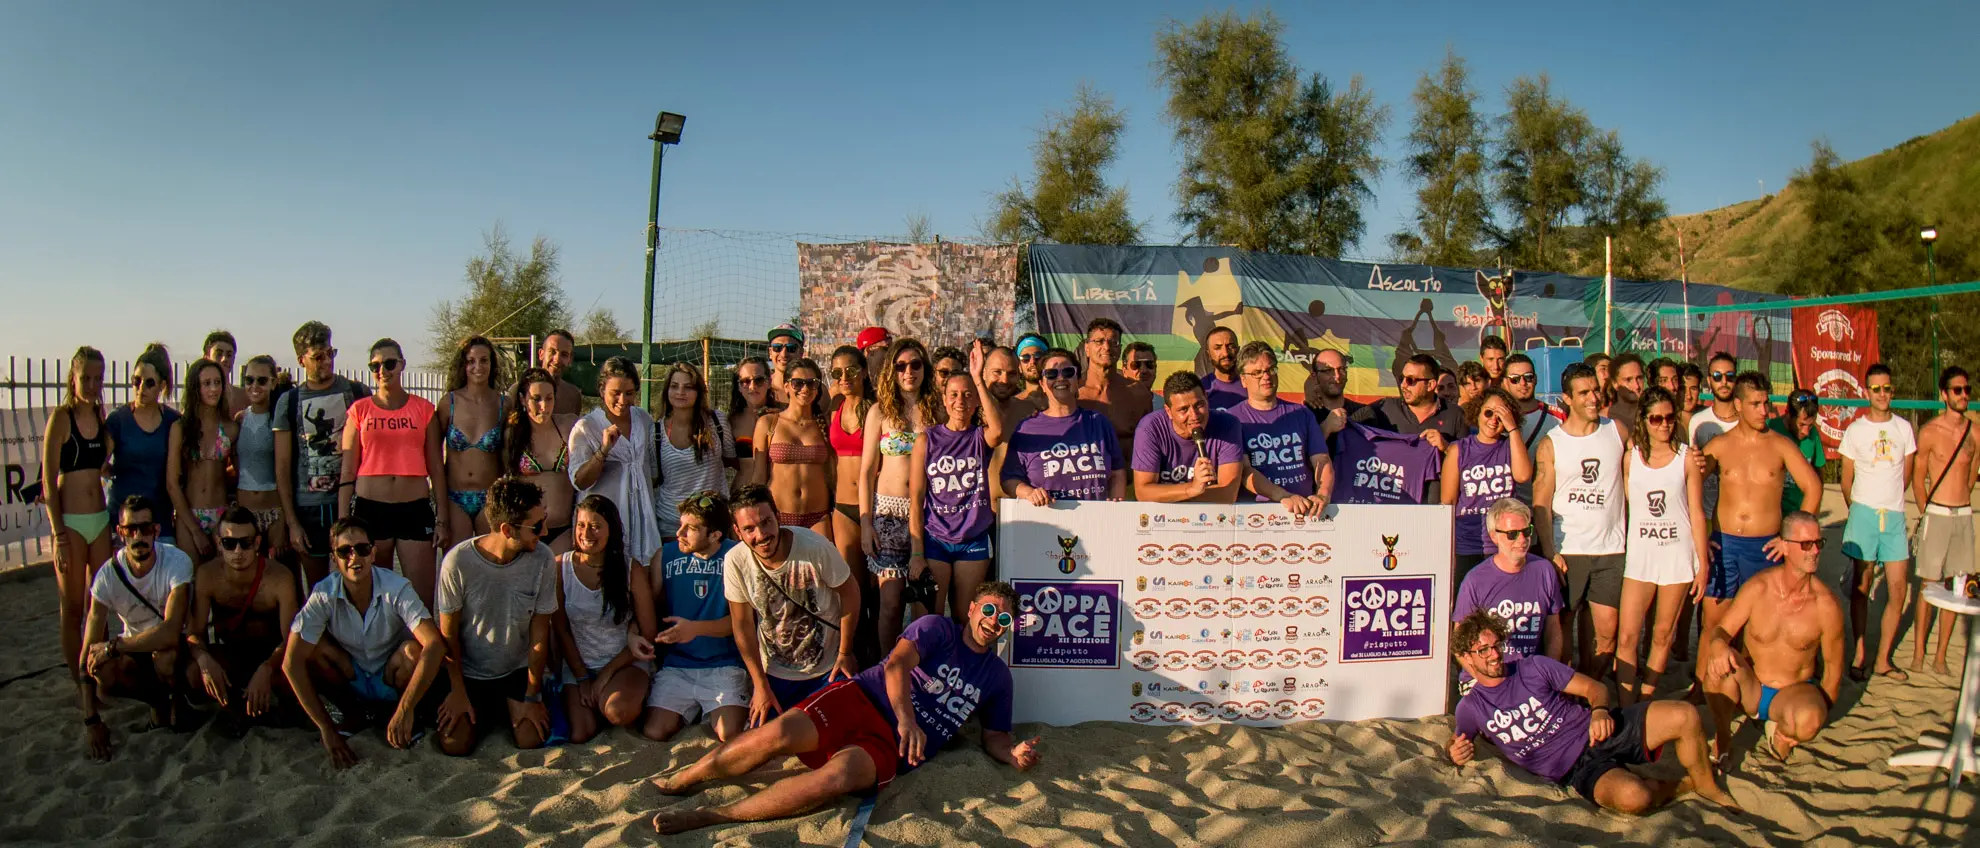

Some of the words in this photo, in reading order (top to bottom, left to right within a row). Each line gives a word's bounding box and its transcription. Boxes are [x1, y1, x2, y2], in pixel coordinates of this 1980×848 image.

[1368, 264, 1442, 293] ASCOLTO
[1072, 279, 1158, 302] LIBERTÀ
[1810, 346, 1851, 363] Sponsored
[1853, 350, 1861, 365] by
[366, 417, 417, 431] FITGIRL
[1040, 442, 1101, 460] COPPA
[1247, 432, 1302, 449] COPPA
[1047, 455, 1106, 477] PACE
[1255, 445, 1304, 466] PACE
[1356, 456, 1404, 477] COPPA
[933, 469, 984, 495] PACE
[1268, 473, 1307, 486] spetto
[1358, 472, 1404, 493] PACE
[1467, 477, 1513, 497] PACE
[1567, 493, 1605, 505] PACE
[1639, 527, 1678, 539] PACE
[1018, 586, 1111, 614] COPPA
[1347, 582, 1426, 610] COPPA
[1026, 613, 1110, 638] PACE
[1348, 611, 1356, 632] DELLA
[1355, 607, 1426, 633] PACE
[1504, 616, 1541, 633] ACE
[1036, 647, 1089, 656] #rispetto
[1363, 640, 1408, 649] #rispetto
[927, 677, 976, 721] PACE
